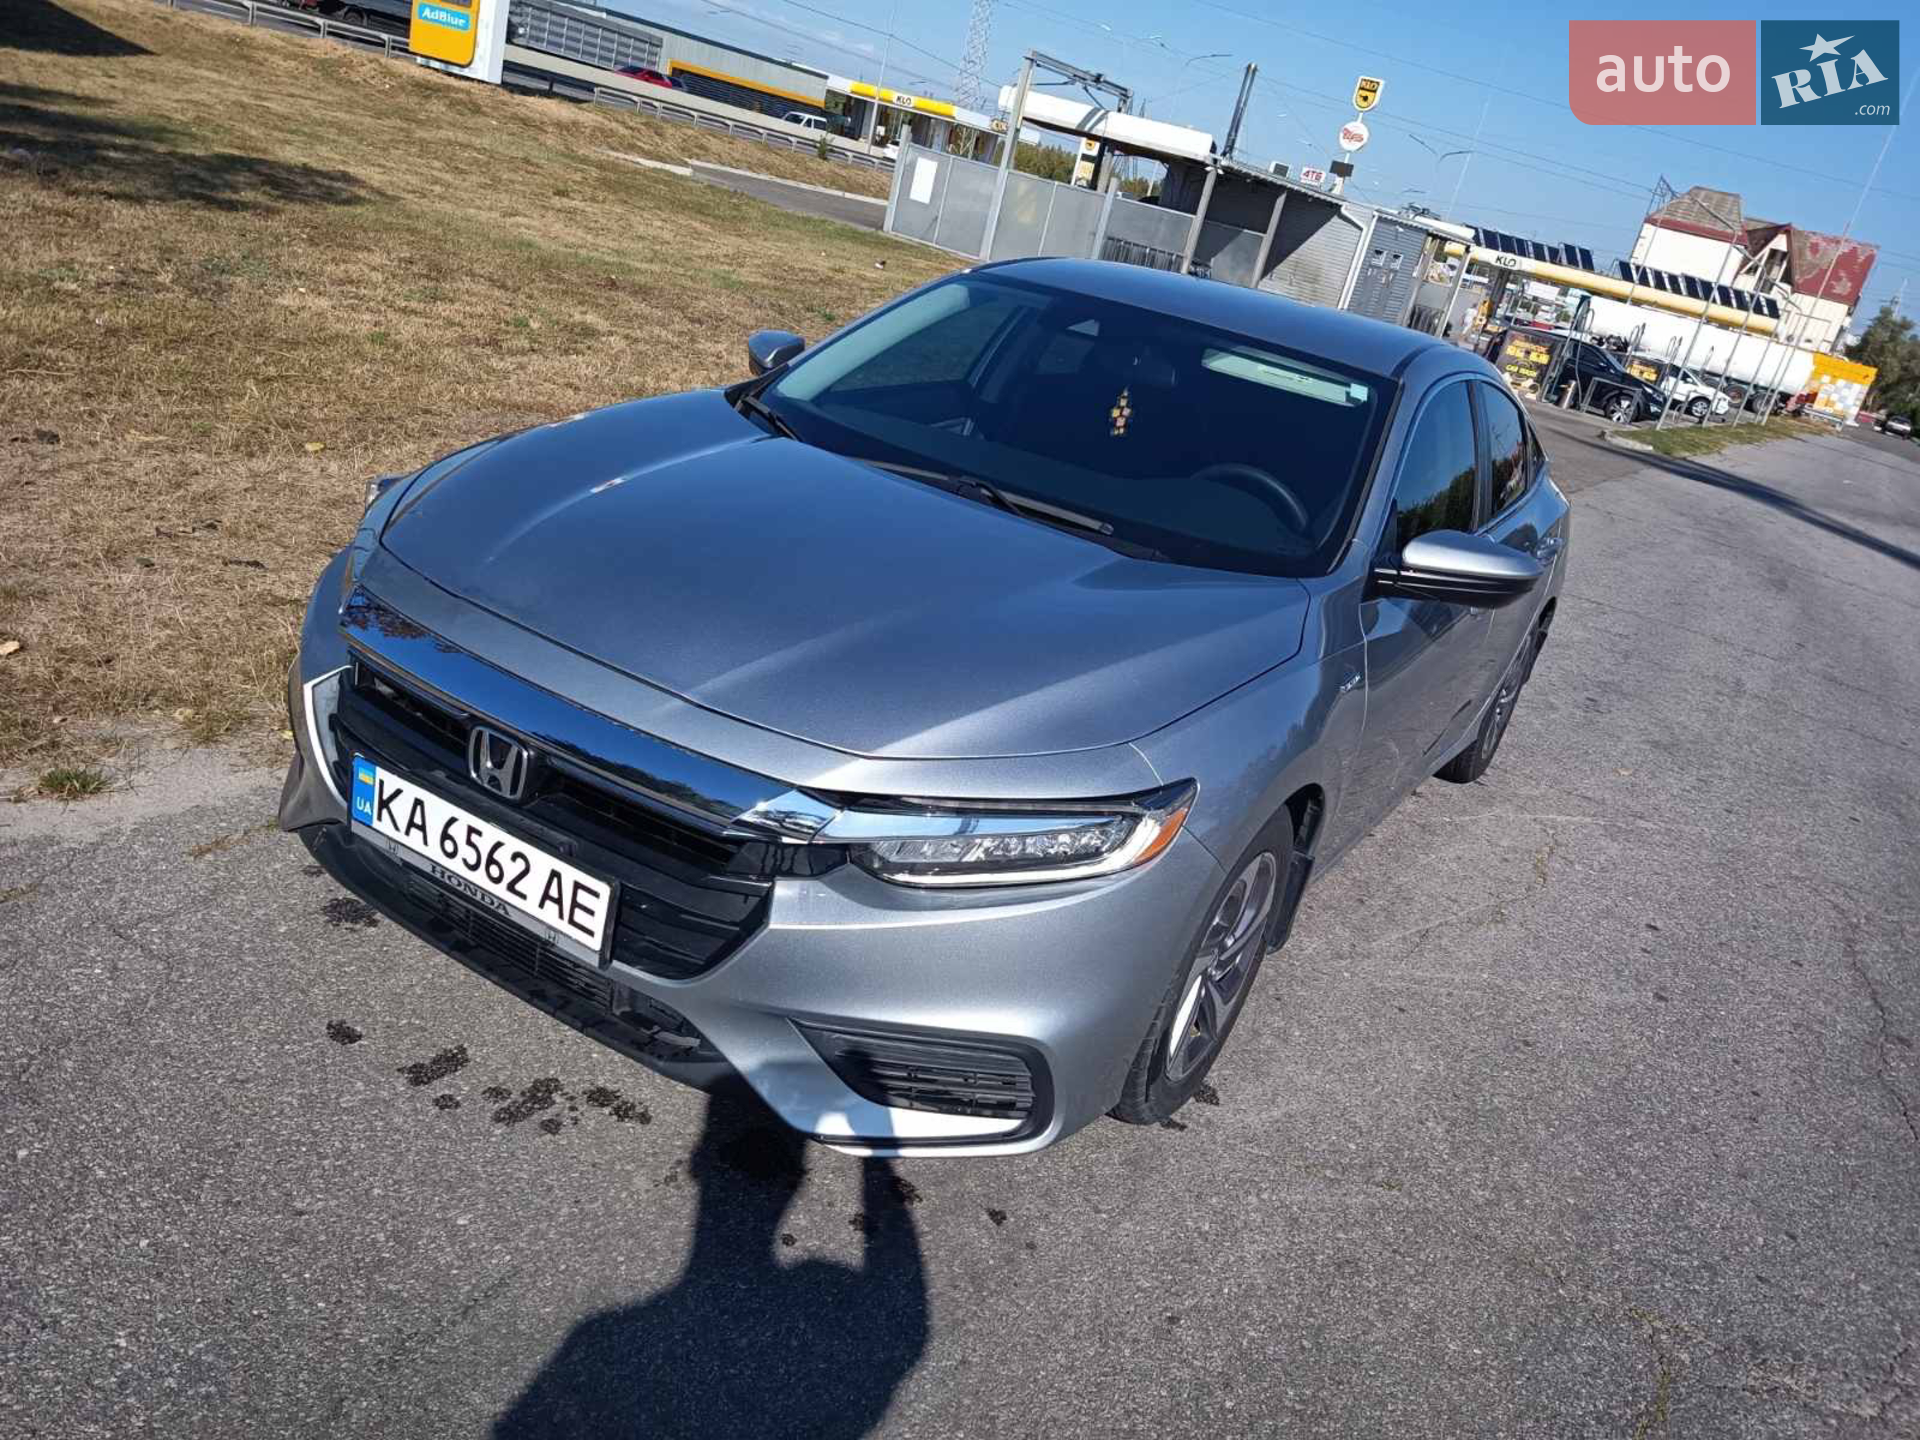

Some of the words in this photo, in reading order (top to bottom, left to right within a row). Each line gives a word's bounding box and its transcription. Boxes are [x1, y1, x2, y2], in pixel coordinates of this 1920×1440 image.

[422, 7, 466, 25] AdBlue
[1495, 255, 1517, 268] KLO
[356, 797, 372, 816] UA
[376, 779, 429, 847] KA
[439, 816, 531, 901] 6562
[538, 868, 601, 938] AE
[429, 862, 512, 918] HONDA
